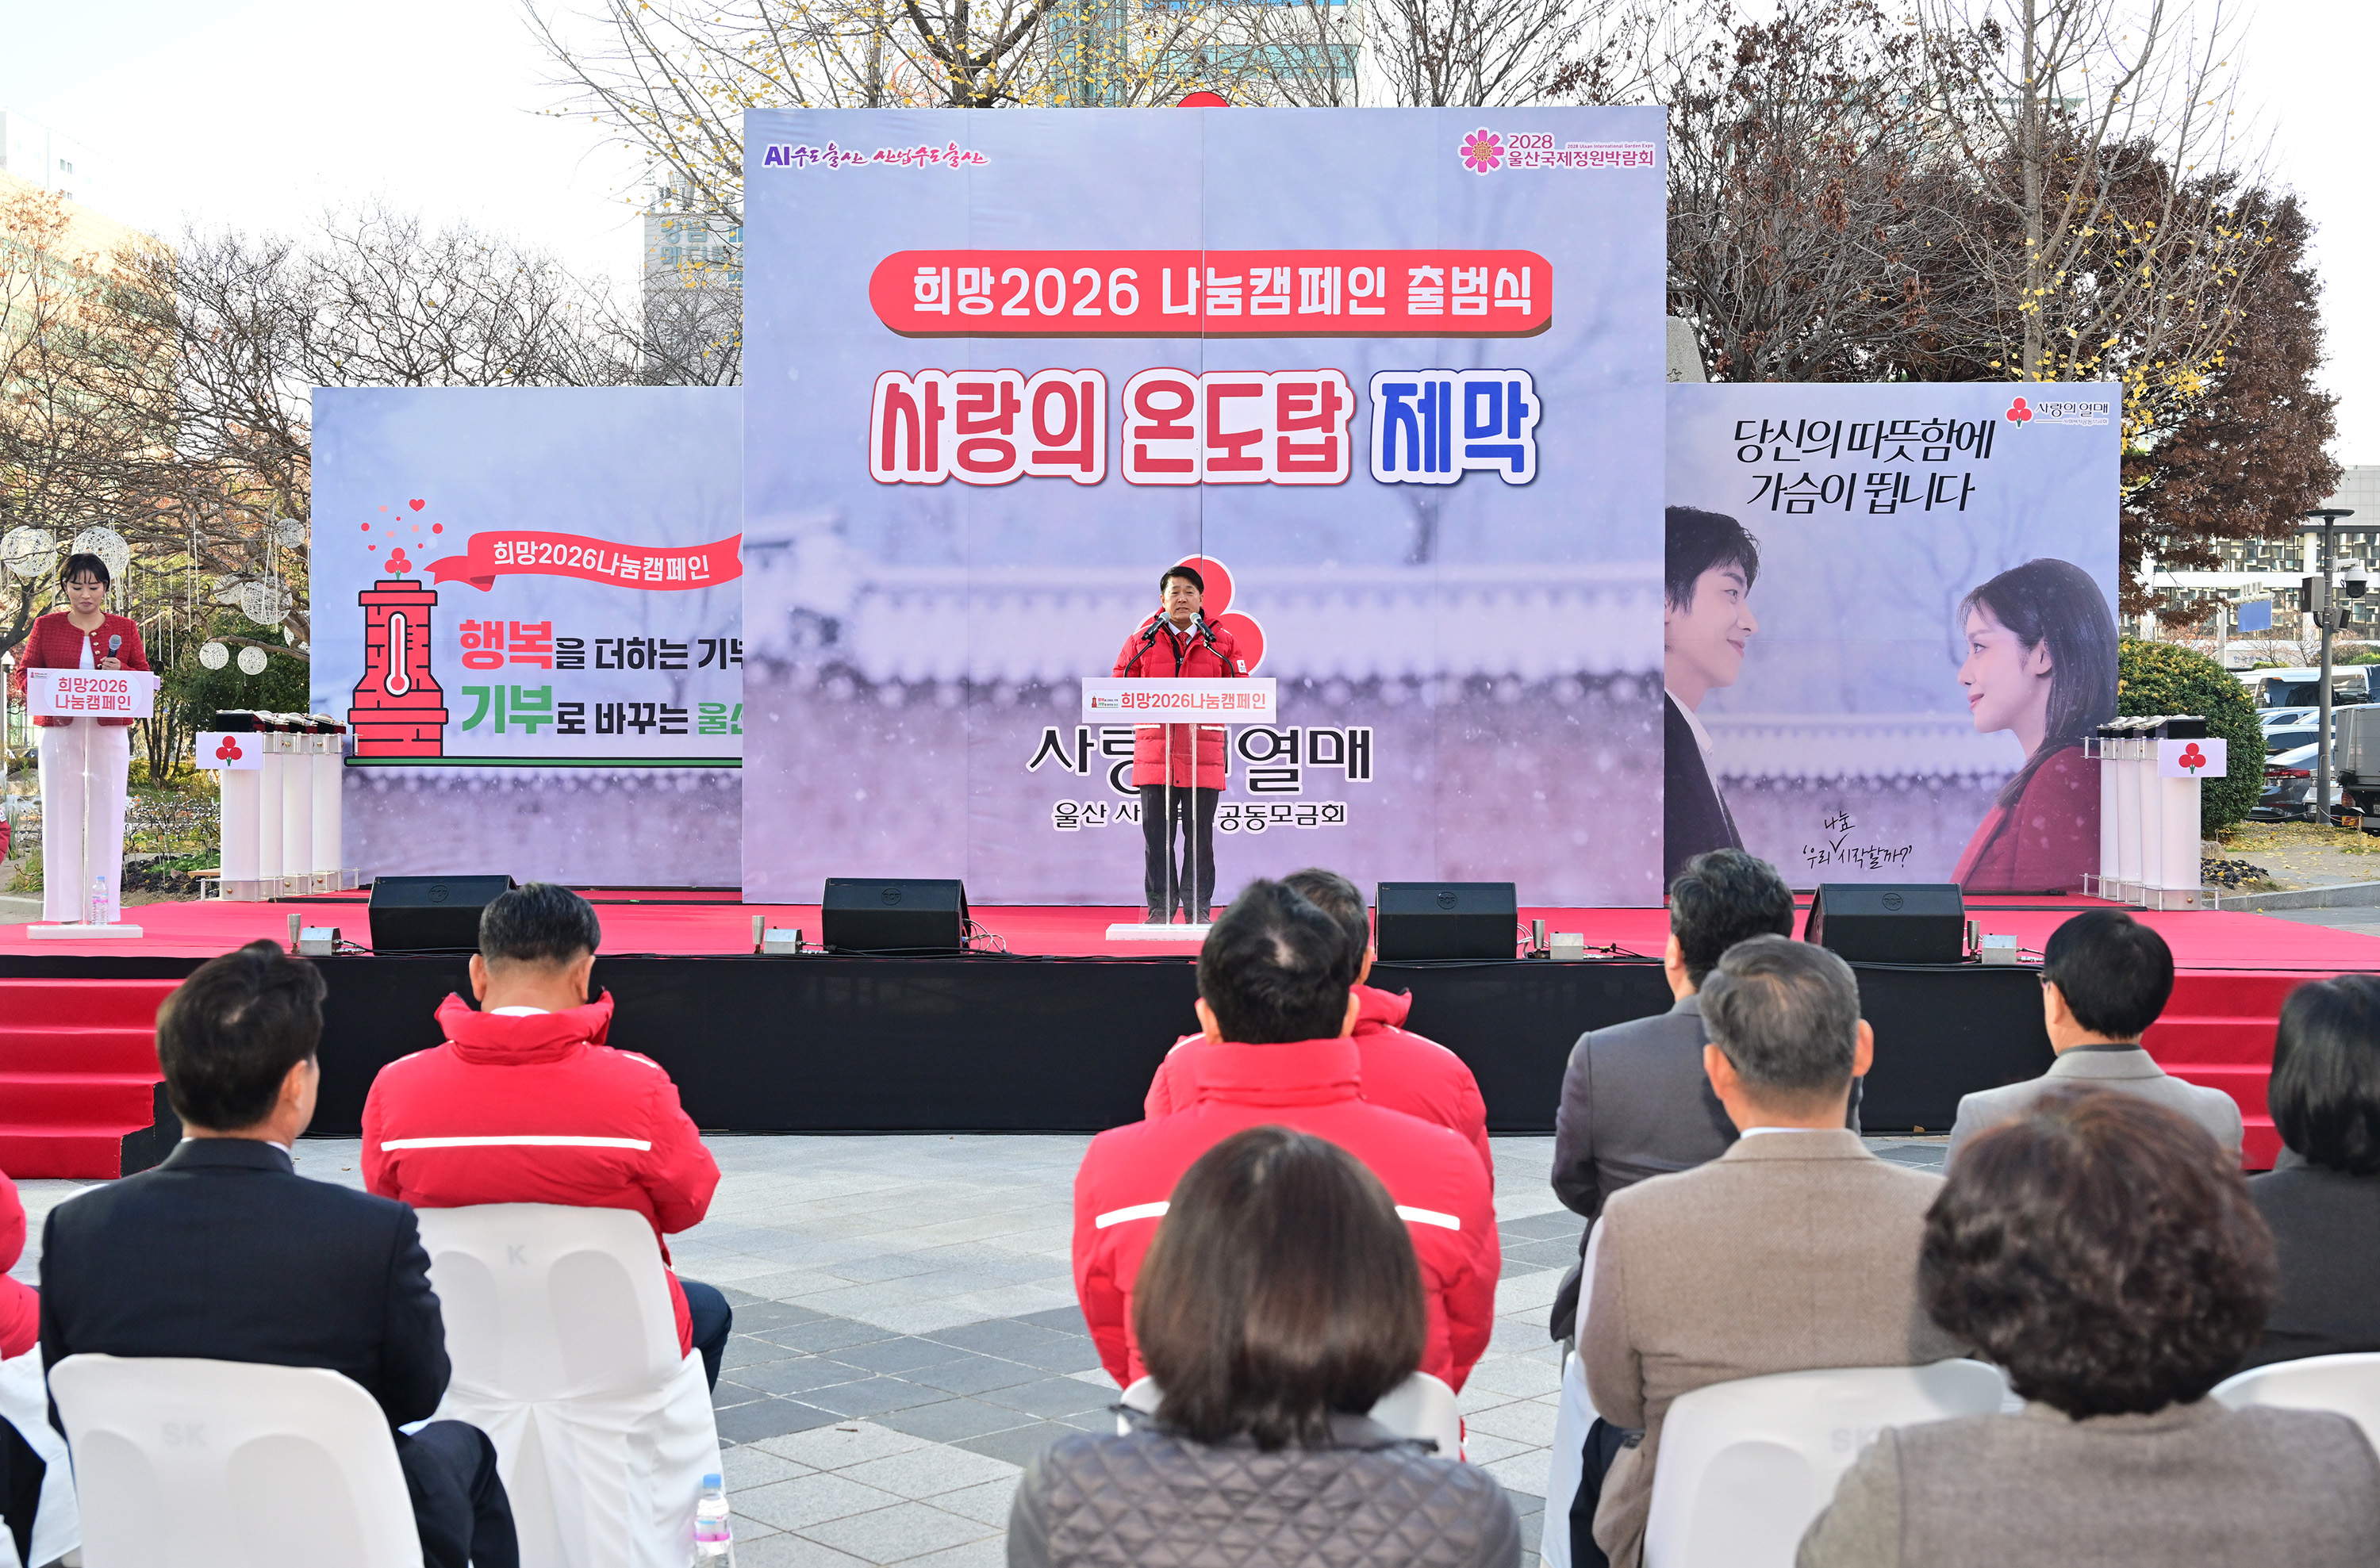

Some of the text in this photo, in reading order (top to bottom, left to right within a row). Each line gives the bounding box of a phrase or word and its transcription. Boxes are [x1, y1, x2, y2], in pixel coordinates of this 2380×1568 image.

[1507, 150, 1653, 167] 울산국제정원박람회
[1509, 134, 1553, 149] 2028
[914, 265, 1531, 316] 희망2026 나눔캠페인 출범식
[880, 379, 1530, 473] 사랑의 온도탑 제막
[2035, 403, 2108, 417] 사랑의 열매
[1734, 417, 1996, 463] 당신의 따뜻함에
[1747, 472, 1975, 515] 가슴이 뜁니다
[493, 541, 710, 582] 희망2026나눔캠페인
[459, 619, 585, 670] 행복을
[595, 637, 689, 670] 더하는
[58, 677, 128, 693] 희망2026
[1121, 692, 1265, 710] 희망2026나눔캠페인
[55, 694, 131, 711] 나눔캠페인
[461, 684, 585, 734] 기부로
[595, 703, 689, 734] 바꾸는
[1238, 728, 1370, 792] 열매
[1054, 803, 1345, 831] 울산 사공동모금회
[1824, 811, 1856, 832] 나눔
